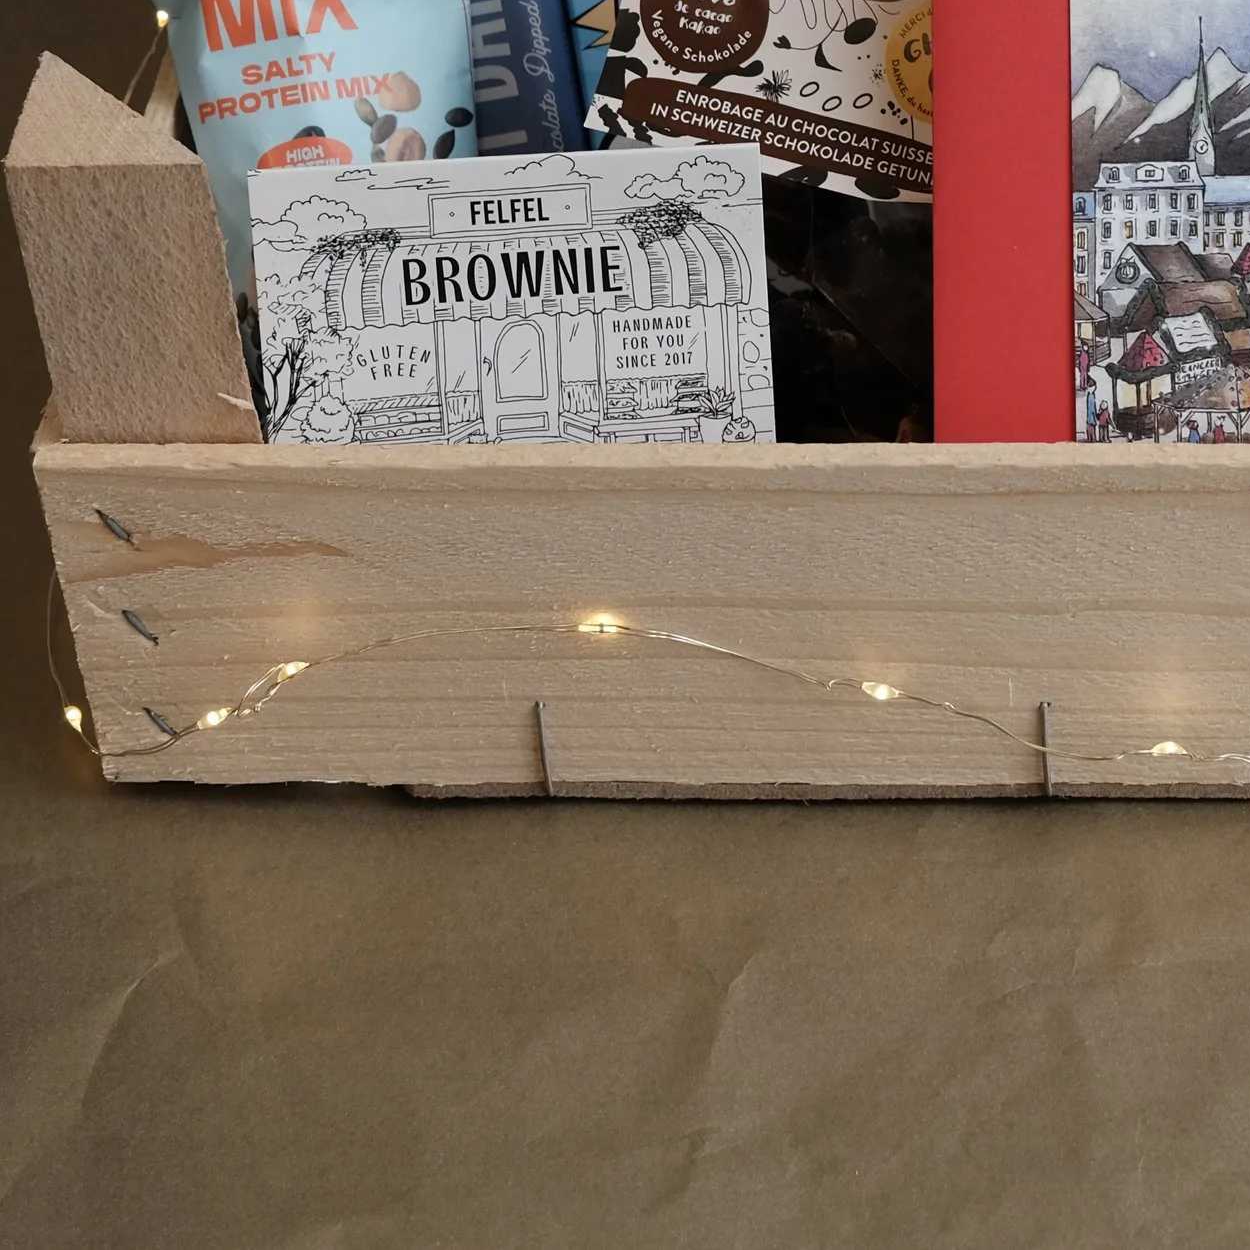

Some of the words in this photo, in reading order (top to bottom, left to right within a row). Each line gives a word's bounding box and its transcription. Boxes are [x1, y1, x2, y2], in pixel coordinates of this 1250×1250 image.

[679, 16, 722, 35] Kakao
[694, 8, 734, 24] cacao
[899, 10, 926, 39] MERCI
[519, 0, 555, 83] Dipped
[651, 10, 680, 54] Vegane
[682, 30, 752, 63] Schokolade
[241, 52, 336, 86] SALTY
[198, 80, 331, 124] PROTEIN
[336, 73, 393, 99] MIX
[539, 88, 565, 152] colate
[675, 89, 764, 124] ENROBAGE
[764, 113, 789, 129] AU
[791, 118, 880, 151] CHOCOLAT
[881, 141, 933, 166] SUISSE
[286, 145, 325, 164] HIGH
[650, 102, 670, 117] IN
[671, 108, 762, 142] SCHWEIZER
[764, 132, 875, 171] SCHOKOLADE
[877, 160, 933, 186] GETUN
[469, 196, 551, 226] FELFEL
[402, 245, 625, 308] BROWNIE
[612, 315, 692, 333] HANDMADE
[356, 344, 431, 367] GLUTEN
[622, 336, 649, 350] FOR
[656, 334, 684, 348] YOU
[370, 362, 418, 381] FREE
[616, 353, 656, 369] SINCE
[665, 351, 693, 366] 2017
